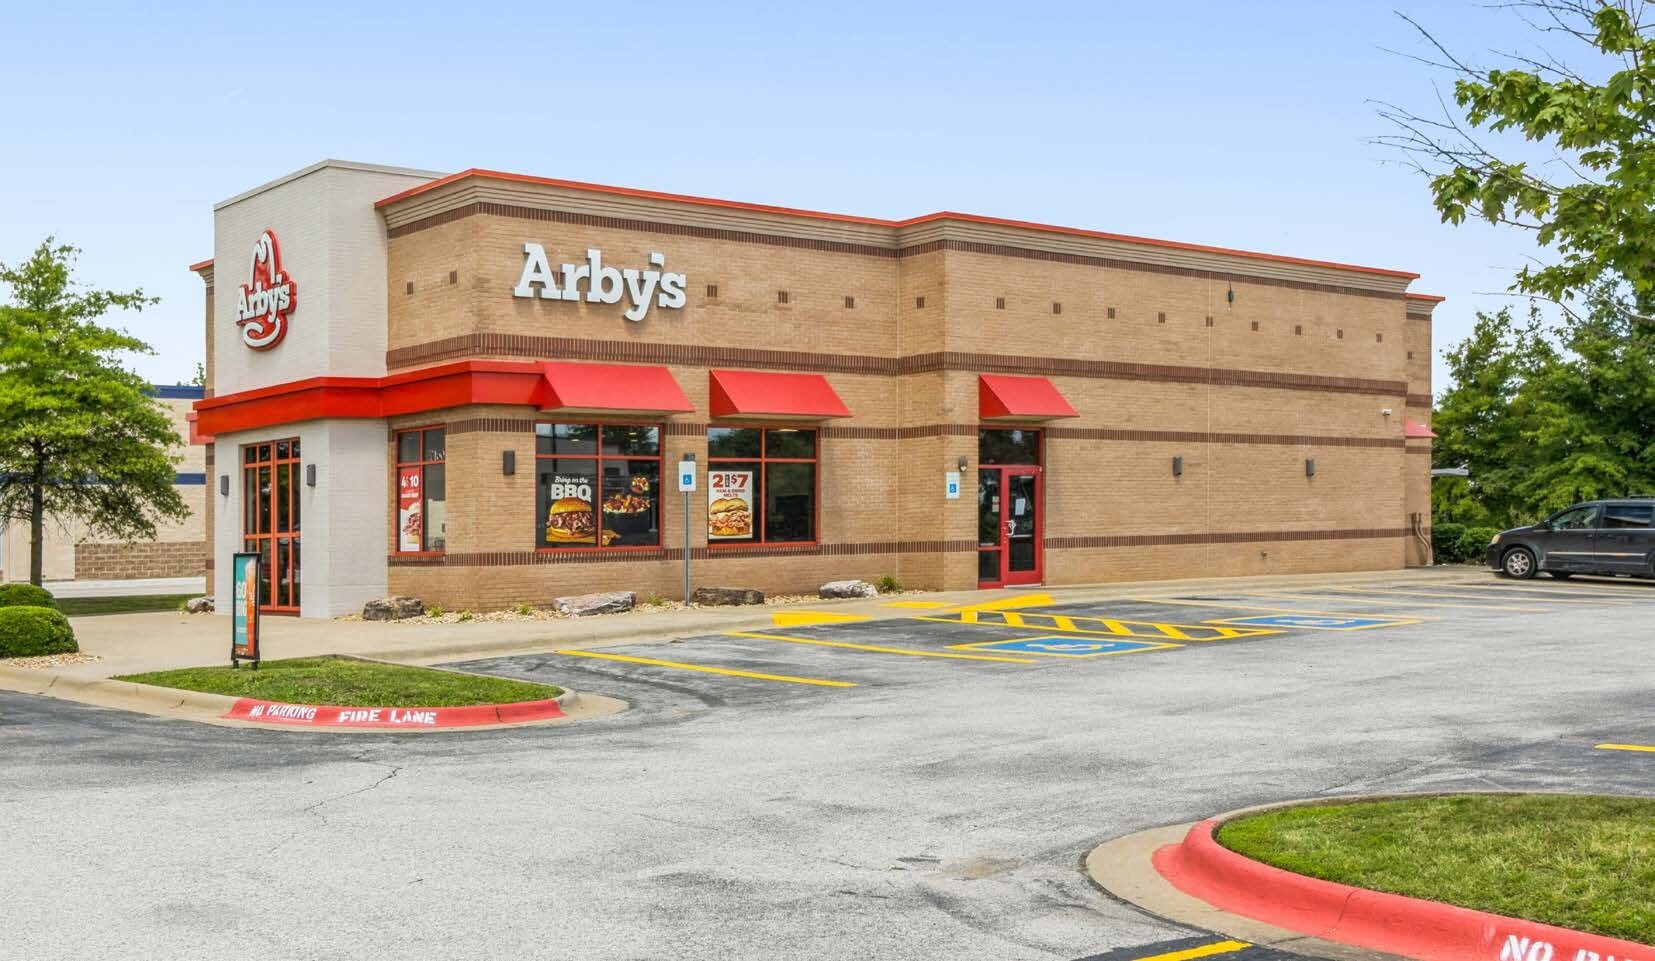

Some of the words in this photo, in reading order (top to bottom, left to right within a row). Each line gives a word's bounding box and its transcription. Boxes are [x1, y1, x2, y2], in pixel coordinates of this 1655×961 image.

[513, 242, 687, 322] Arby's
[236, 273, 291, 323] Arby's
[713, 474, 723, 487] 2
[731, 474, 748, 487] $7
[551, 483, 592, 502] BBQ
[250, 705, 263, 717] NO
[266, 704, 317, 718] PARKING
[338, 710, 381, 722] FIRE
[390, 710, 437, 723] LANE
[1500, 934, 1554, 961] NO
